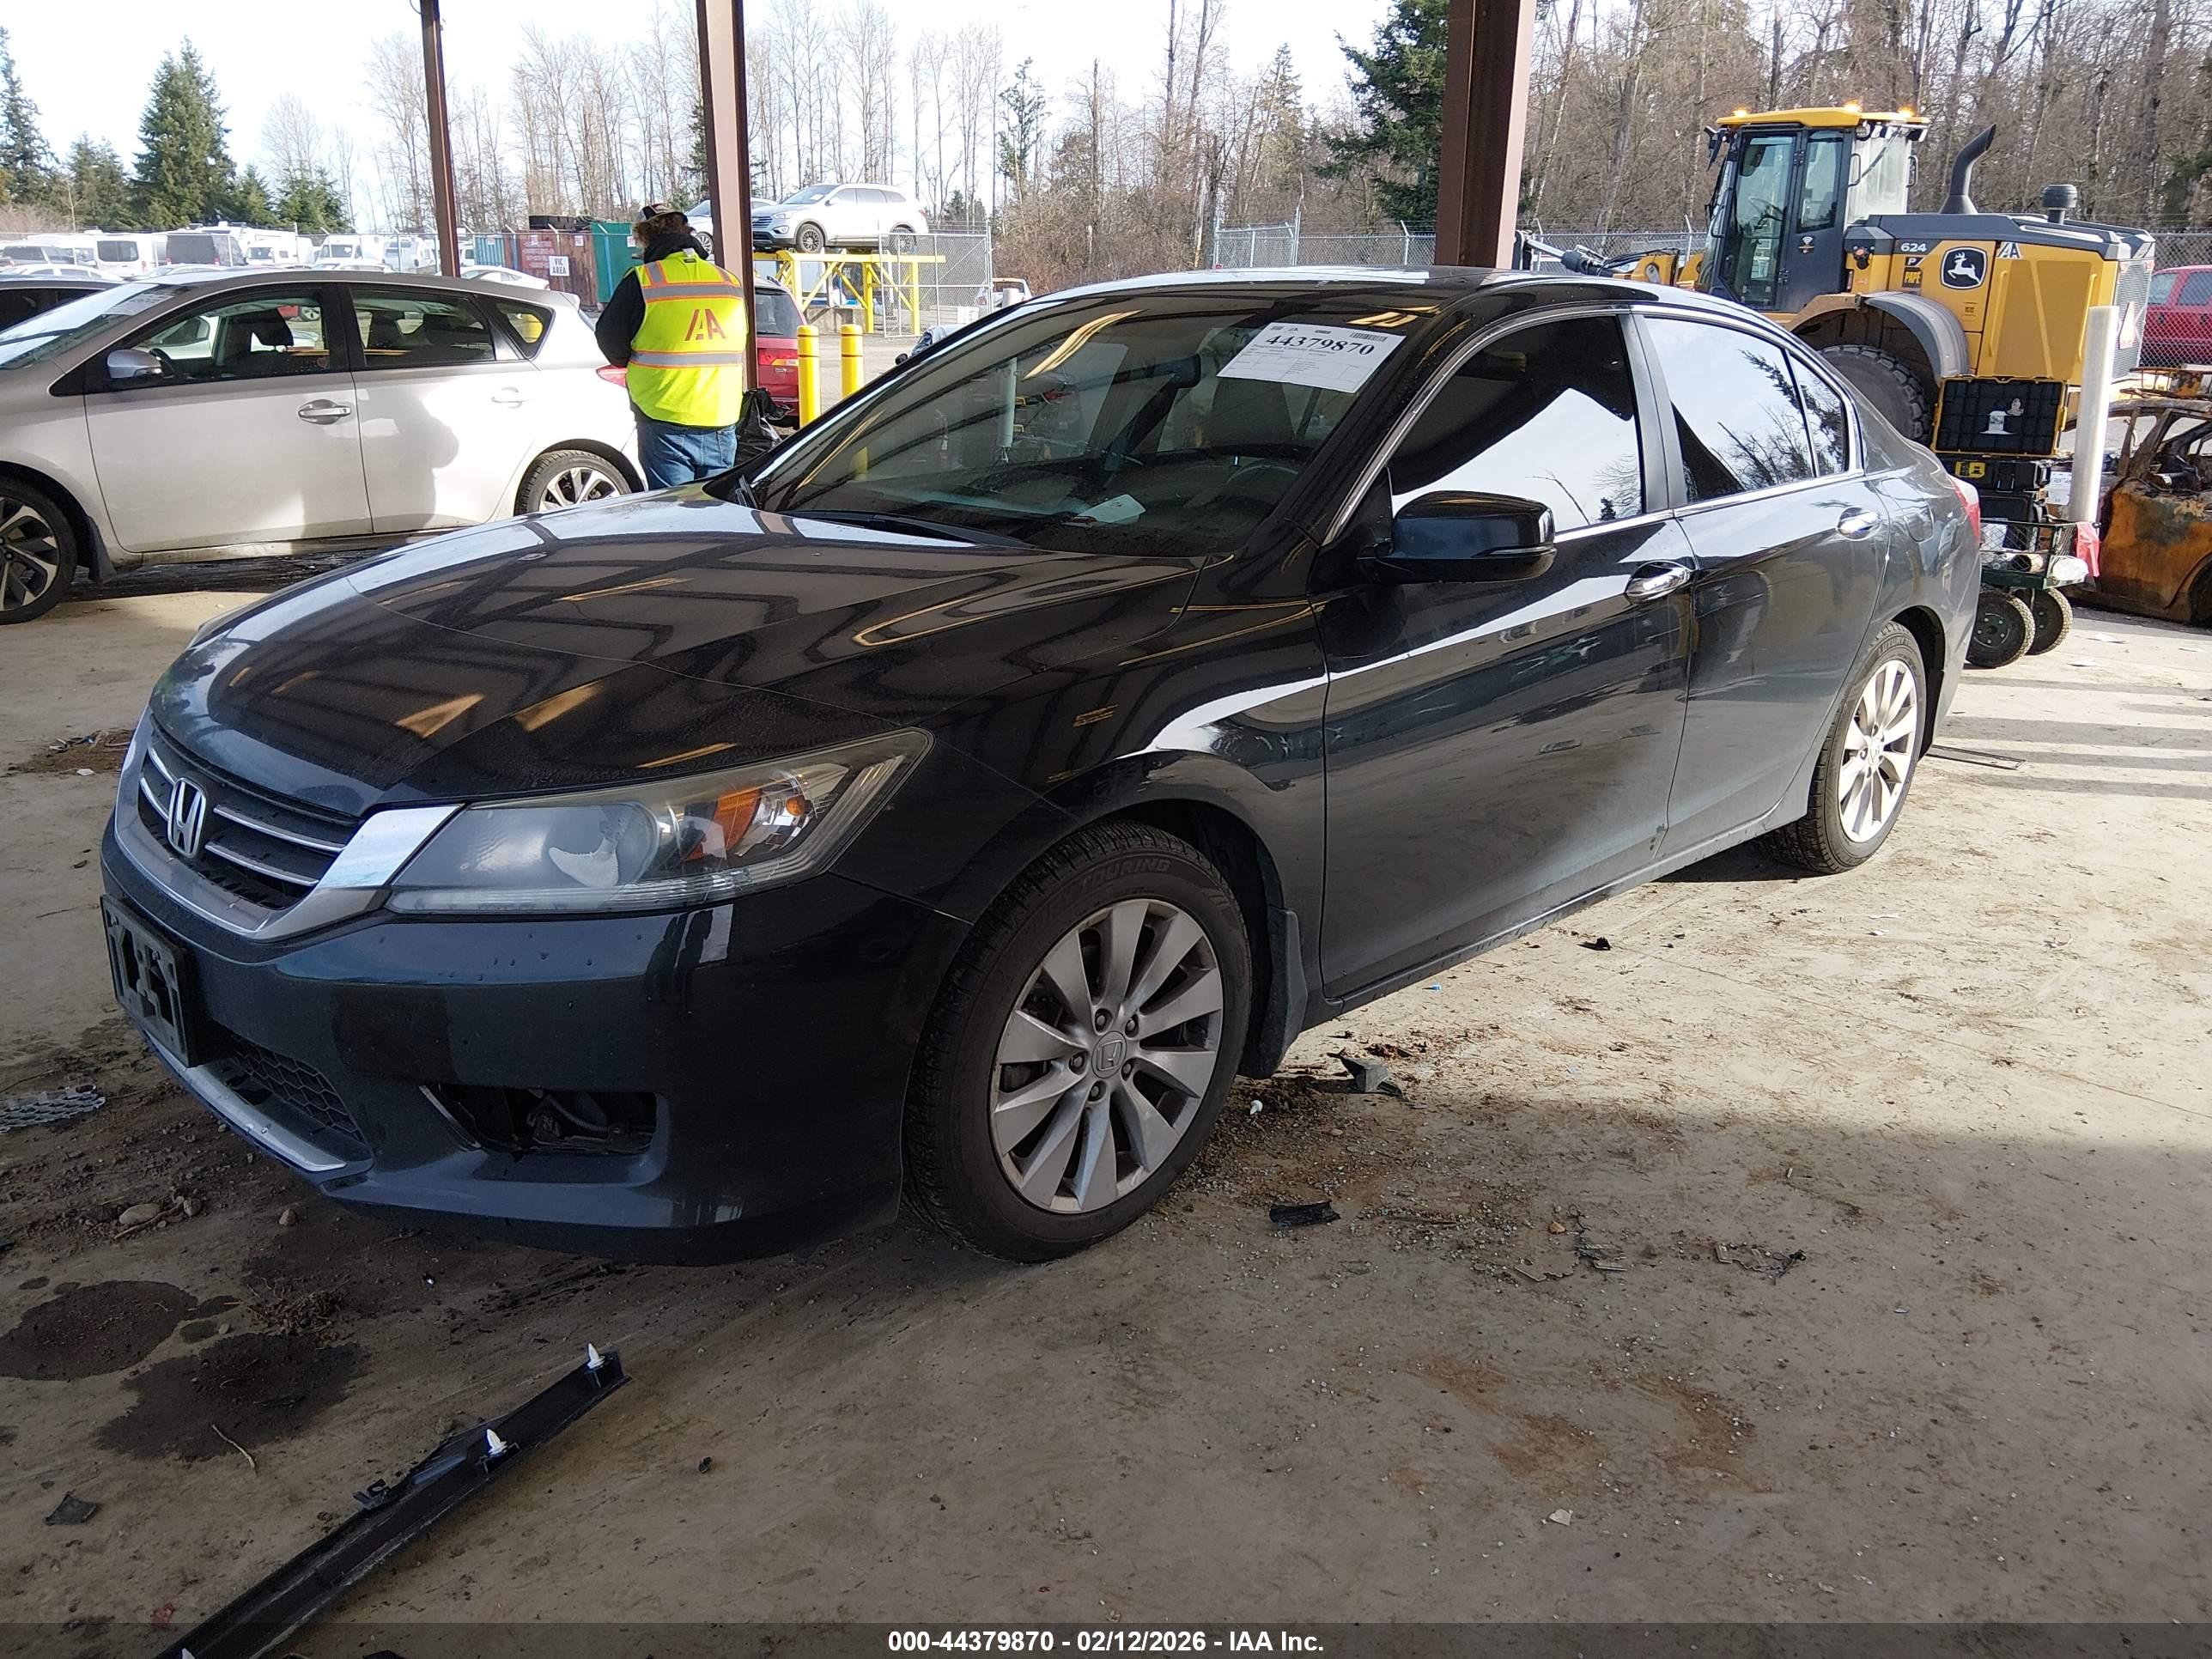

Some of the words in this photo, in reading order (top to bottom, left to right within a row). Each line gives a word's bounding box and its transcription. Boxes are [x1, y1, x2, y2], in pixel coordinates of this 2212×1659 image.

[1900, 242, 1927, 252] 624
[553, 266, 567, 275] AREA
[1265, 335, 1376, 356] 44379870
